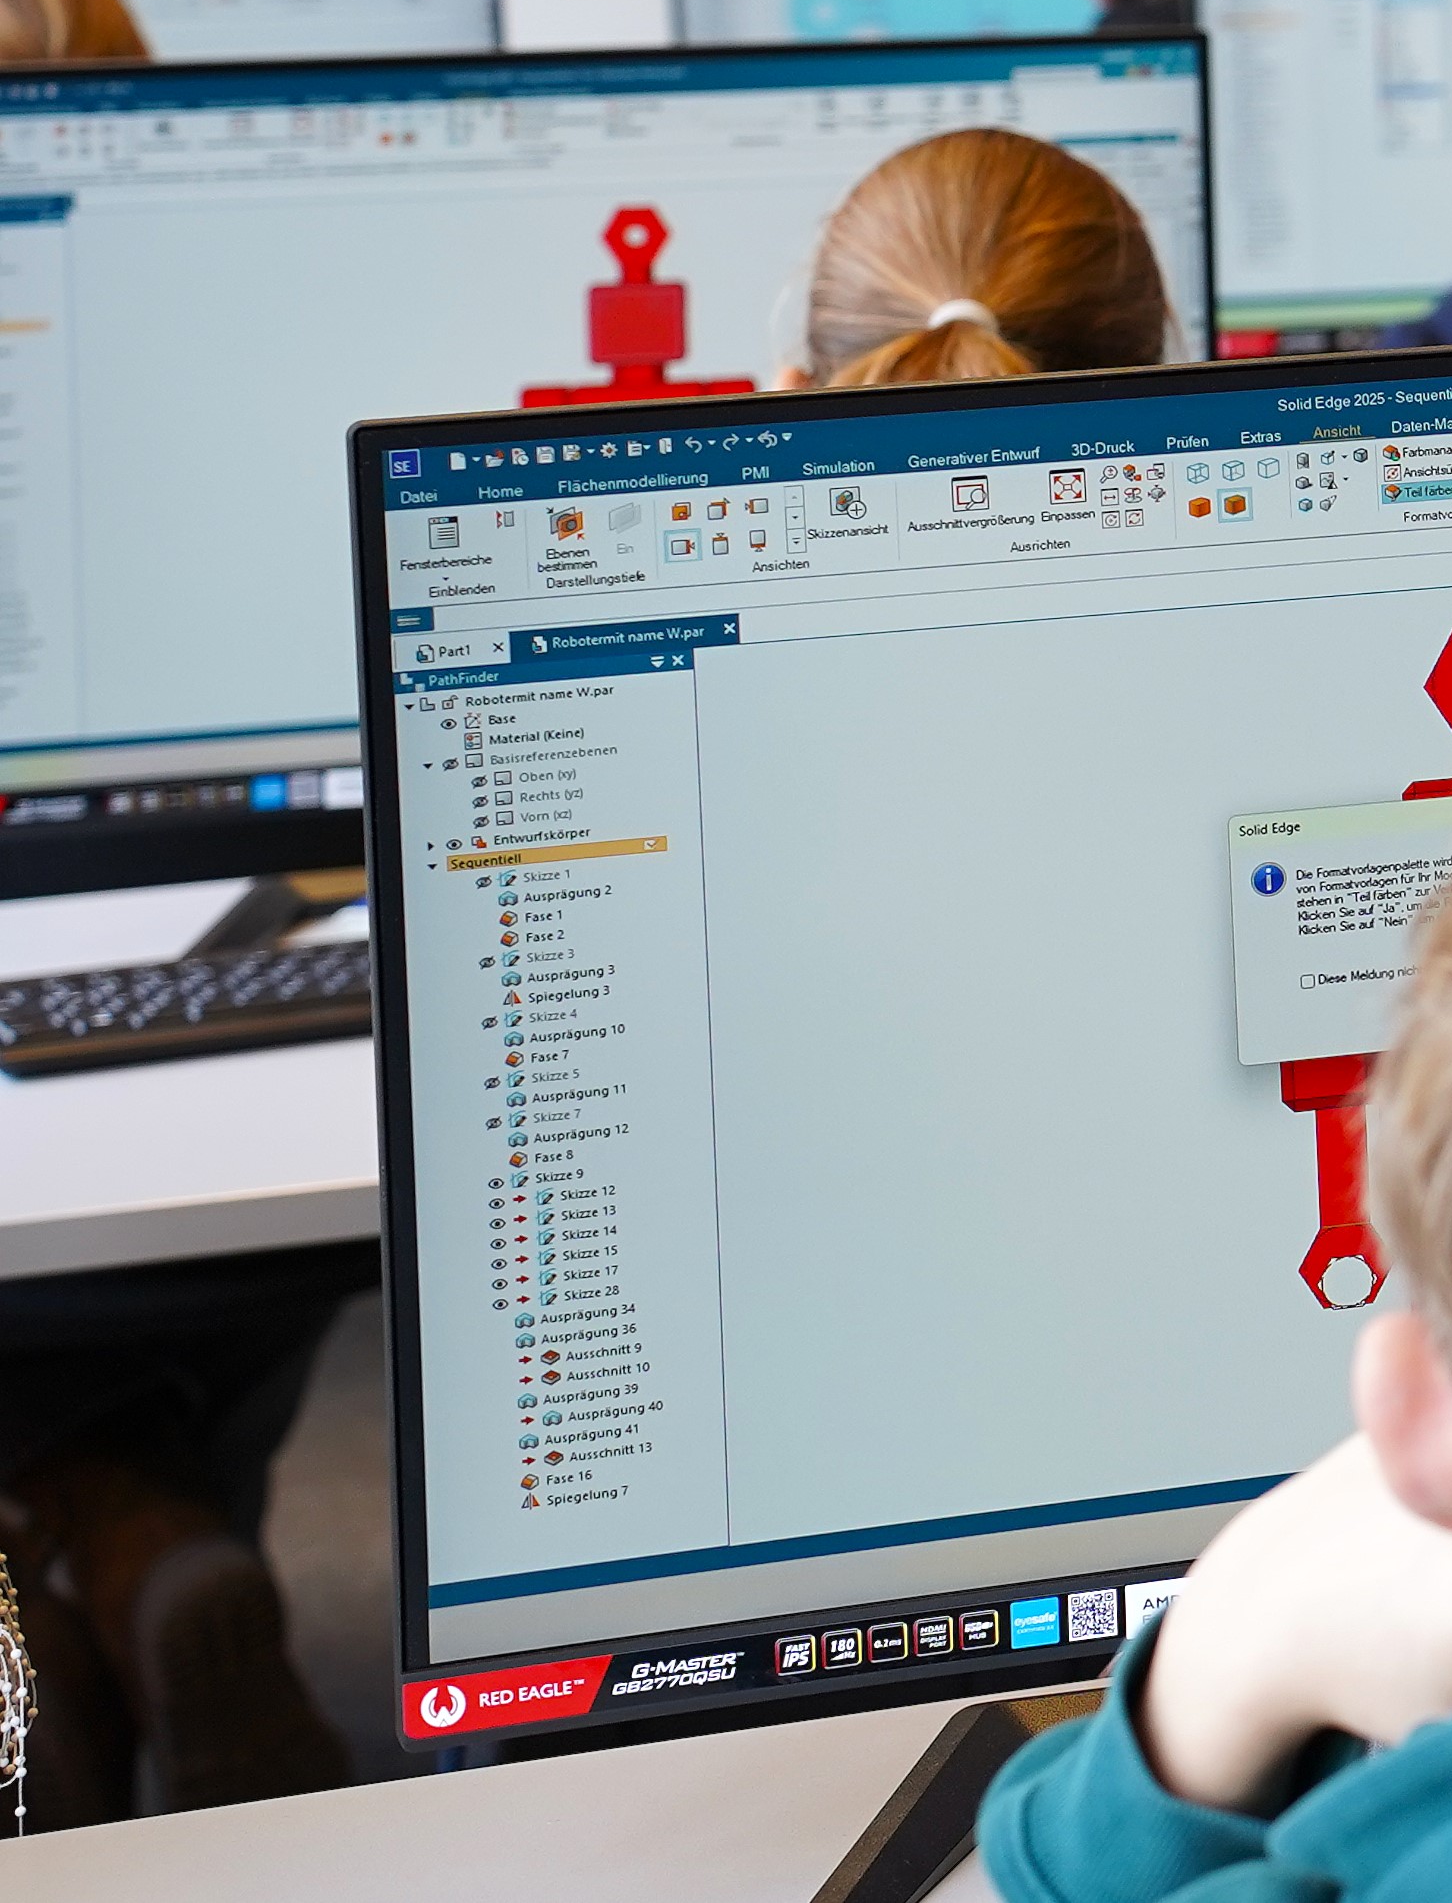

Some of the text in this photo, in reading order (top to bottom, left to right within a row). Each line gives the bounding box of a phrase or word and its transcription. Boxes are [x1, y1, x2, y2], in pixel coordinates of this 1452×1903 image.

[1277, 397, 1311, 411] Solid
[1314, 395, 1350, 410] Edge
[1353, 392, 1385, 406] 2025
[1240, 431, 1281, 444] Extras
[1312, 424, 1361, 438] Ansicht
[1071, 440, 1135, 456] 3D-Druck
[1166, 435, 1208, 449] Prüfen
[907, 446, 1040, 467] Generativer Entwurf
[393, 460, 411, 473] SE
[742, 466, 769, 479] PMI
[802, 460, 874, 475] Simulation
[558, 473, 708, 493] Flächenmodellierung
[400, 489, 437, 504] Datei
[478, 486, 523, 499] Home
[1400, 486, 1423, 497] Teil
[907, 514, 1034, 531] Ausschnittvergrößerung
[1040, 510, 1095, 522] Einpassen
[807, 523, 888, 539] Skizzenansicht
[1010, 539, 1070, 552] Ausrichten
[546, 548, 589, 559] Ebenen
[400, 554, 491, 570] Fensterbereiche
[537, 560, 597, 572] bestimmen
[752, 559, 809, 572] Ansichten
[546, 570, 645, 588] Darstellungstiefe
[428, 583, 495, 597] Einblenden
[552, 627, 704, 648] Robotermit name W.par
[438, 644, 469, 657] Part1
[428, 671, 499, 686] PathFinder
[465, 686, 613, 706] Robotermit name W.par
[488, 714, 515, 724] Base
[489, 727, 584, 744] Material (Keine)
[489, 746, 617, 765] Basisreferenzebenen
[518, 768, 576, 782] Oben (xy)
[520, 787, 583, 802] Rechts (yz)
[520, 808, 571, 822] Vorn (xz)
[1239, 821, 1300, 836] Solid Edge
[493, 829, 590, 845] Entwurfskörper
[450, 853, 521, 869] Sequentiell
[1296, 869, 1313, 880] Die
[1316, 859, 1429, 877] Formatvorlagenpalette
[1432, 855, 1452, 867] wird
[523, 884, 611, 902] Ausprägung 2
[525, 909, 561, 922] Fase 1
[1318, 966, 1418, 984] Diese Meldung nich
[528, 985, 609, 1004] Spiegelung 3
[529, 1023, 625, 1042] Ausprägung 10
[540, 1303, 635, 1323] Ausprägung 34
[546, 1469, 592, 1485] Fase 16
[830, 1638, 855, 1653] 180
[782, 1650, 810, 1668] IPS
[611, 1666, 736, 1695] GB2770QSU
[477, 1689, 513, 1706] RED
